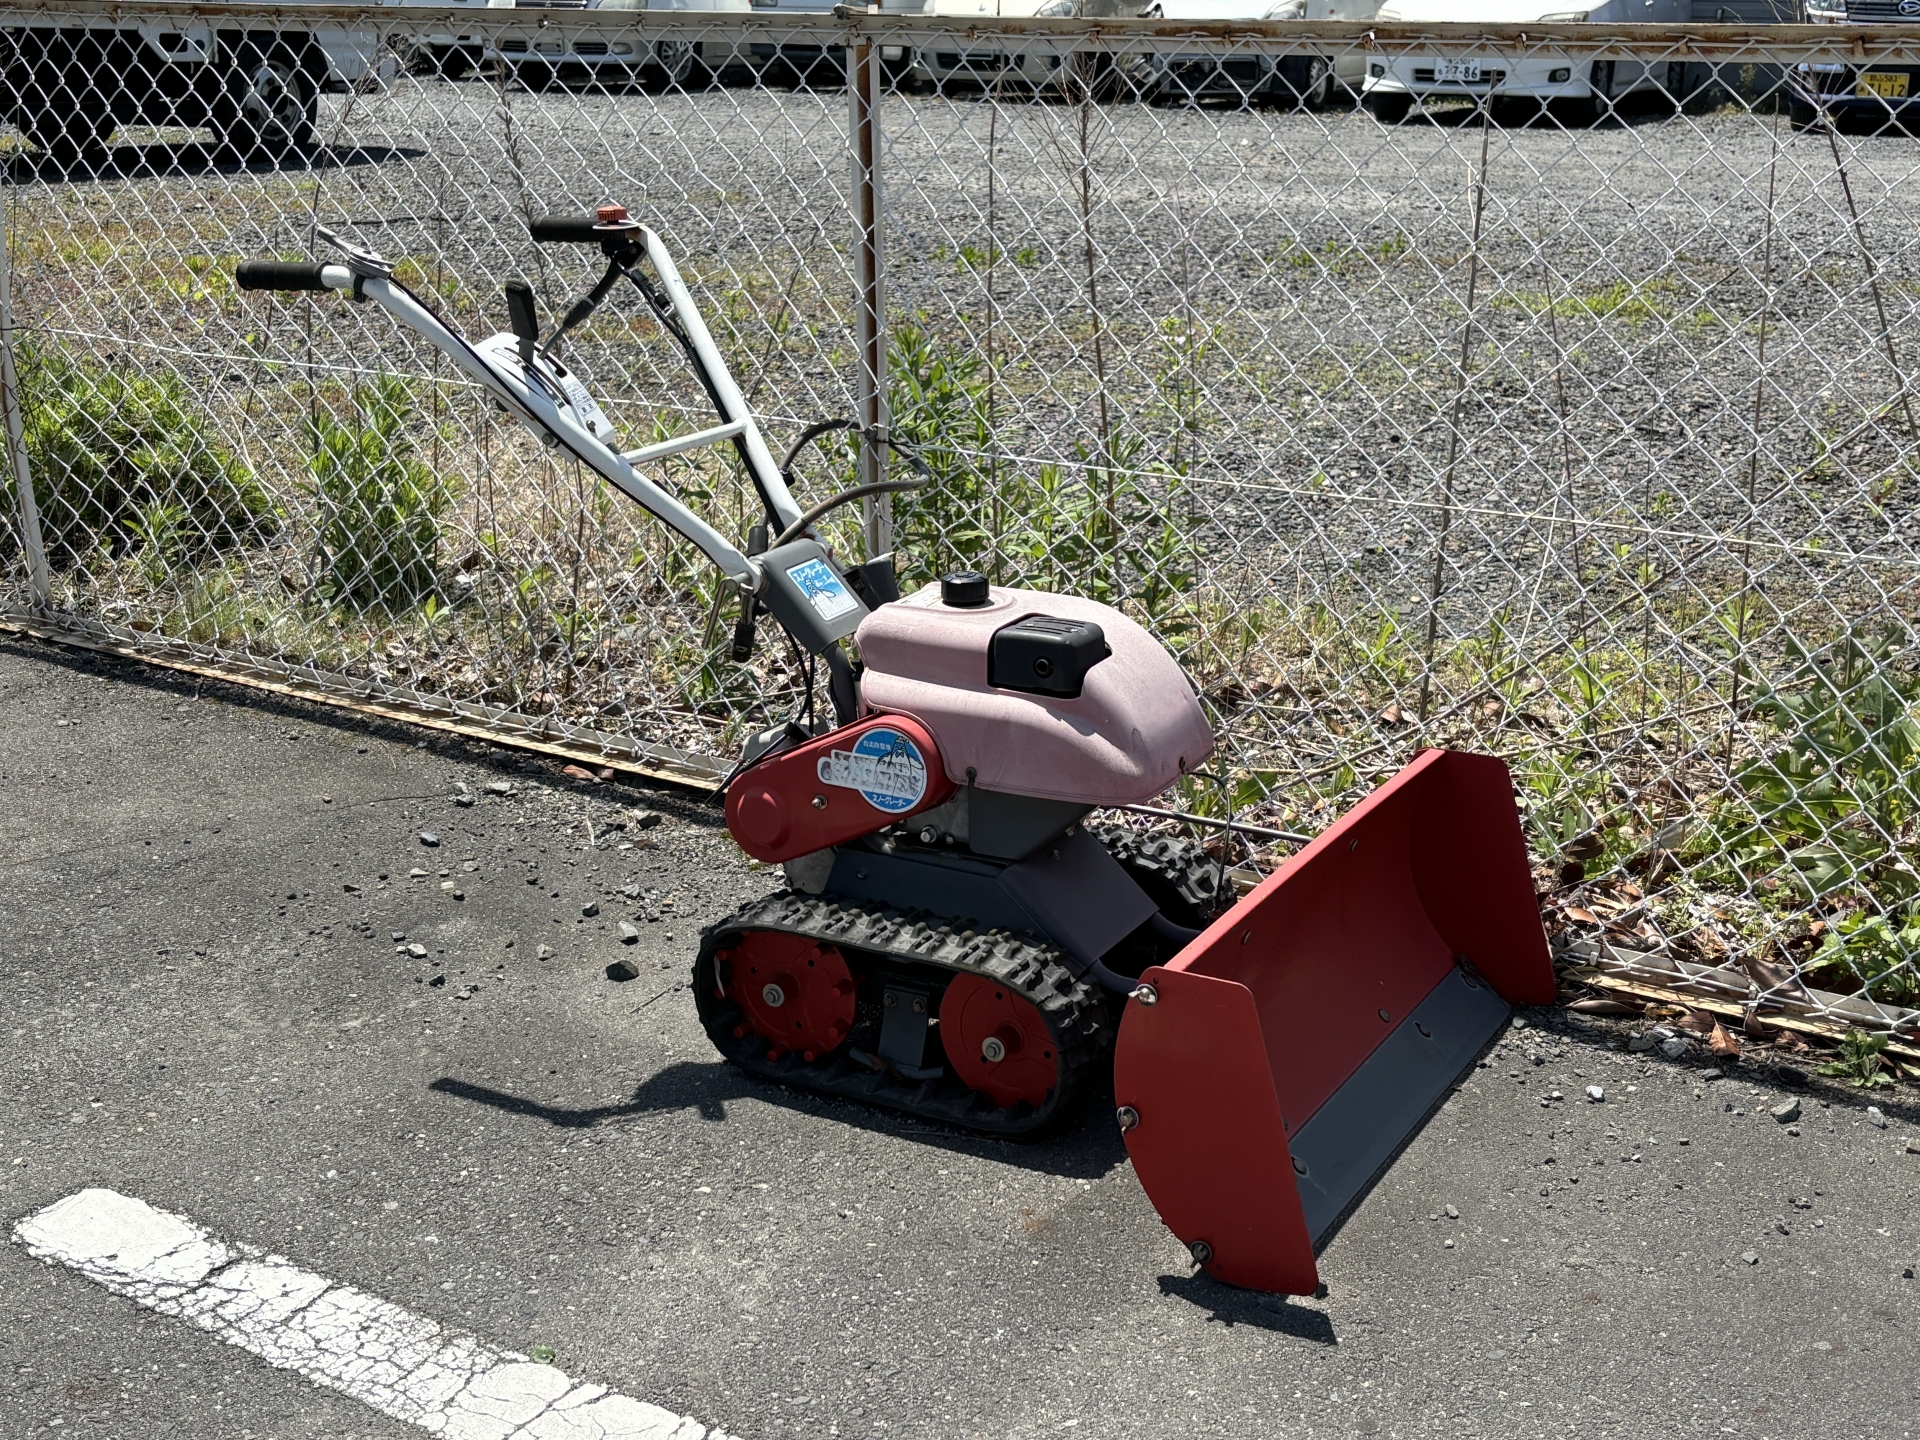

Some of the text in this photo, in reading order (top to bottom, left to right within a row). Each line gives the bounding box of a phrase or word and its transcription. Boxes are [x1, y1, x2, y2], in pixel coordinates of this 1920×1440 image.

[872, 794, 907, 807] スノーグレーダー
